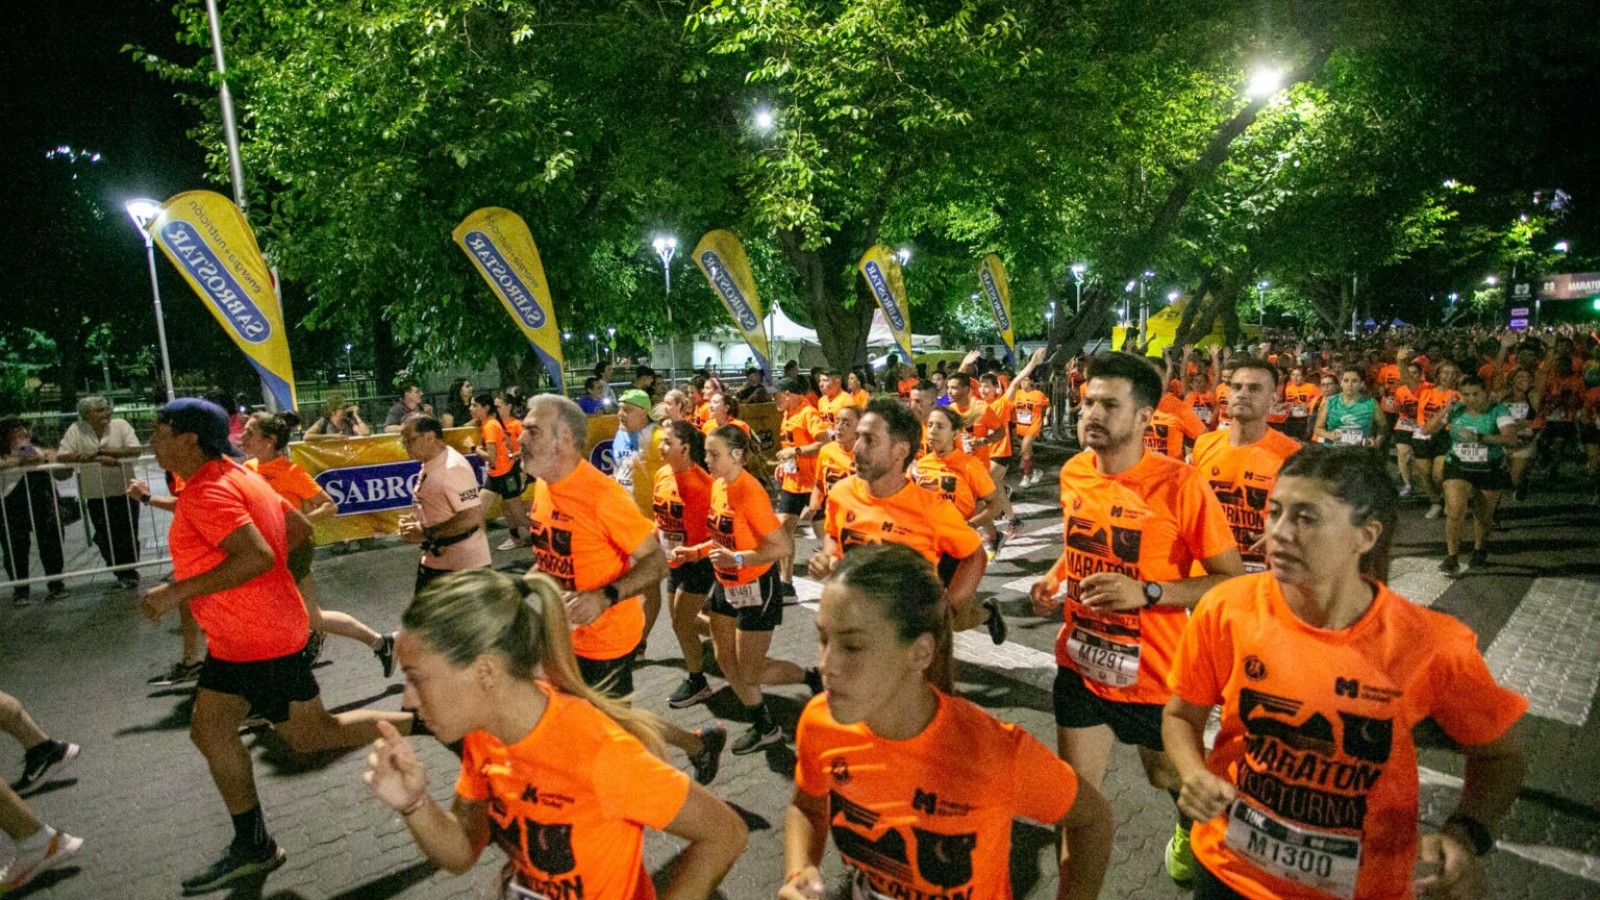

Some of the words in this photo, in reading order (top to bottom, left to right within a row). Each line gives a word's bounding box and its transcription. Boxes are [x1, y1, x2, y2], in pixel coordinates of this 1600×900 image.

[325, 474, 421, 506] SABRO
[1078, 644, 1125, 672] M1291
[1246, 830, 1334, 878] M1300
